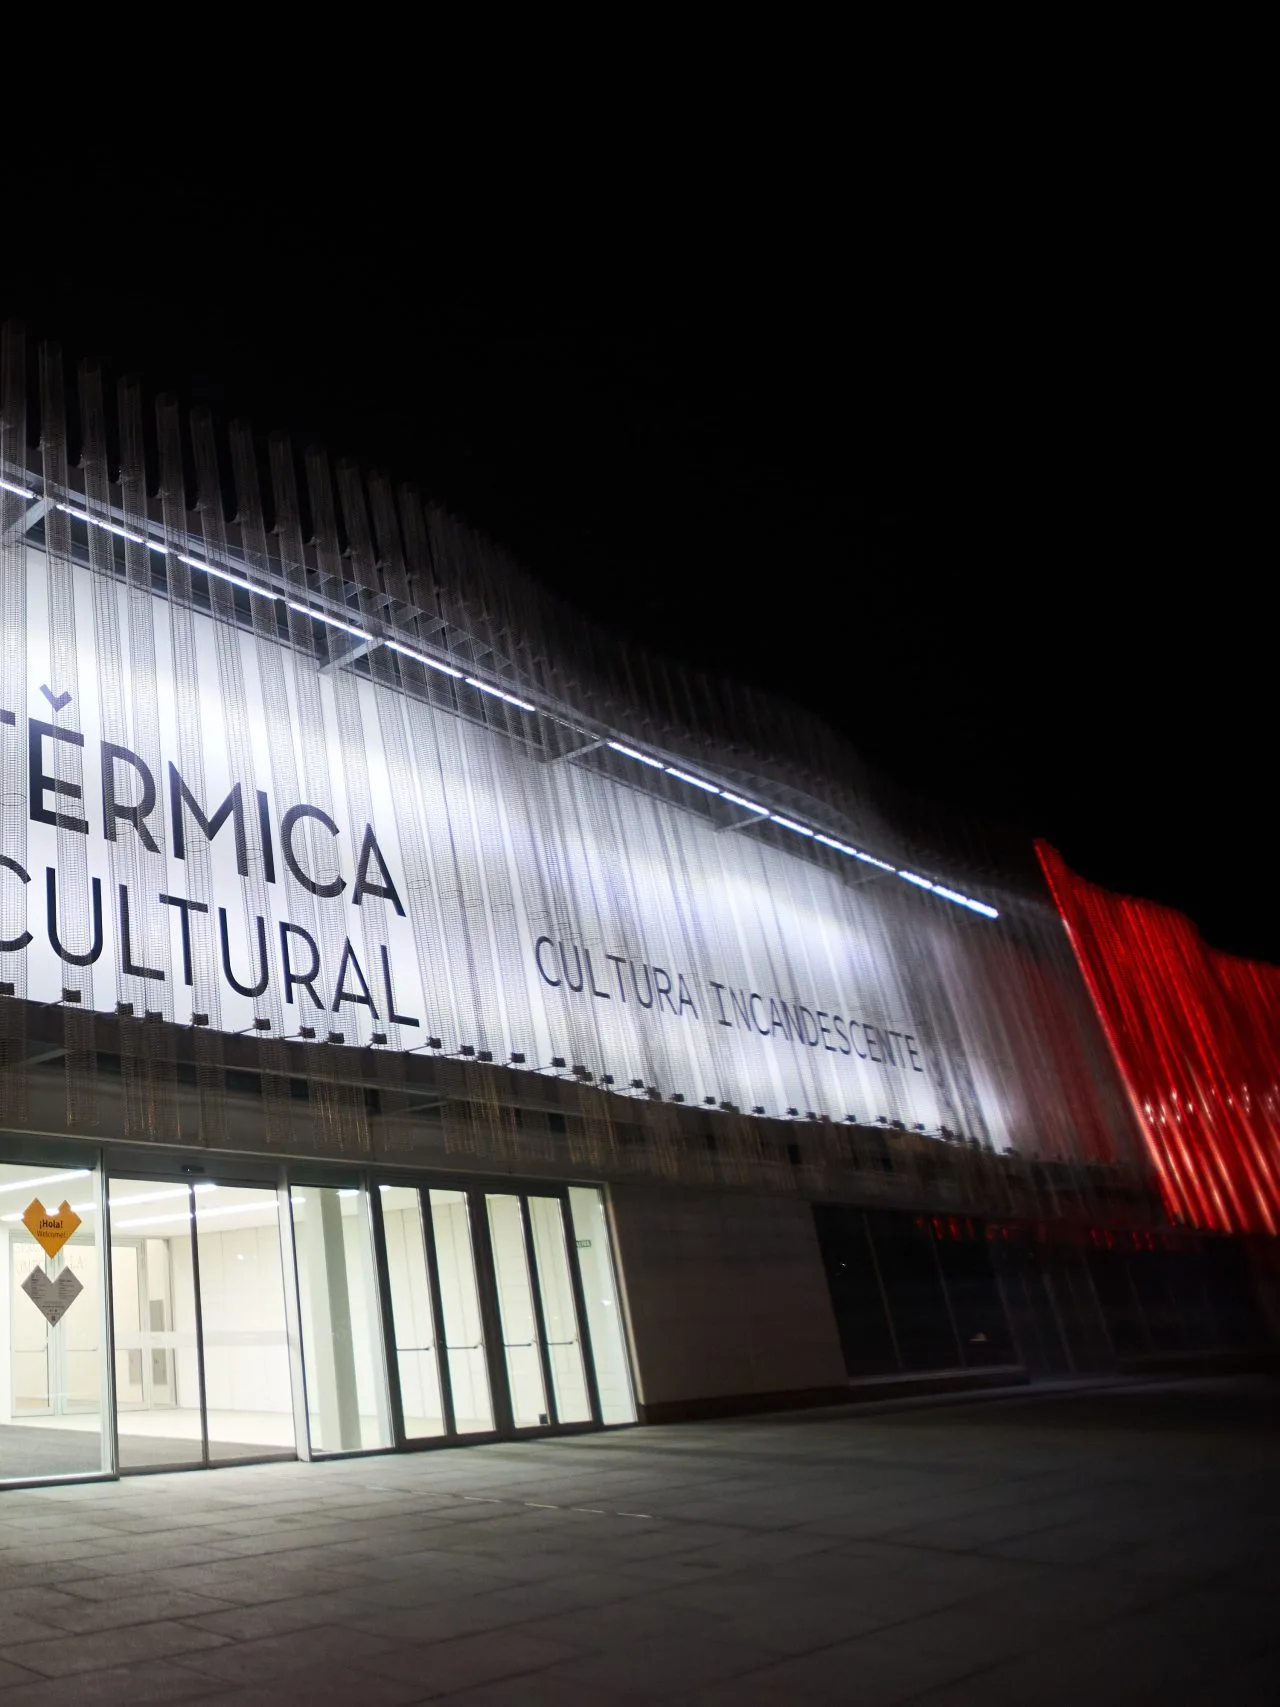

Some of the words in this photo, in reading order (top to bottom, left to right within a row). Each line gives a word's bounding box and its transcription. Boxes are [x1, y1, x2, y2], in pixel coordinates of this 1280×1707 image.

[535, 936, 698, 1019] CULTURA
[710, 981, 924, 1073] INCANDESCENTE
[39, 1219, 63, 1230] ¡Hola!
